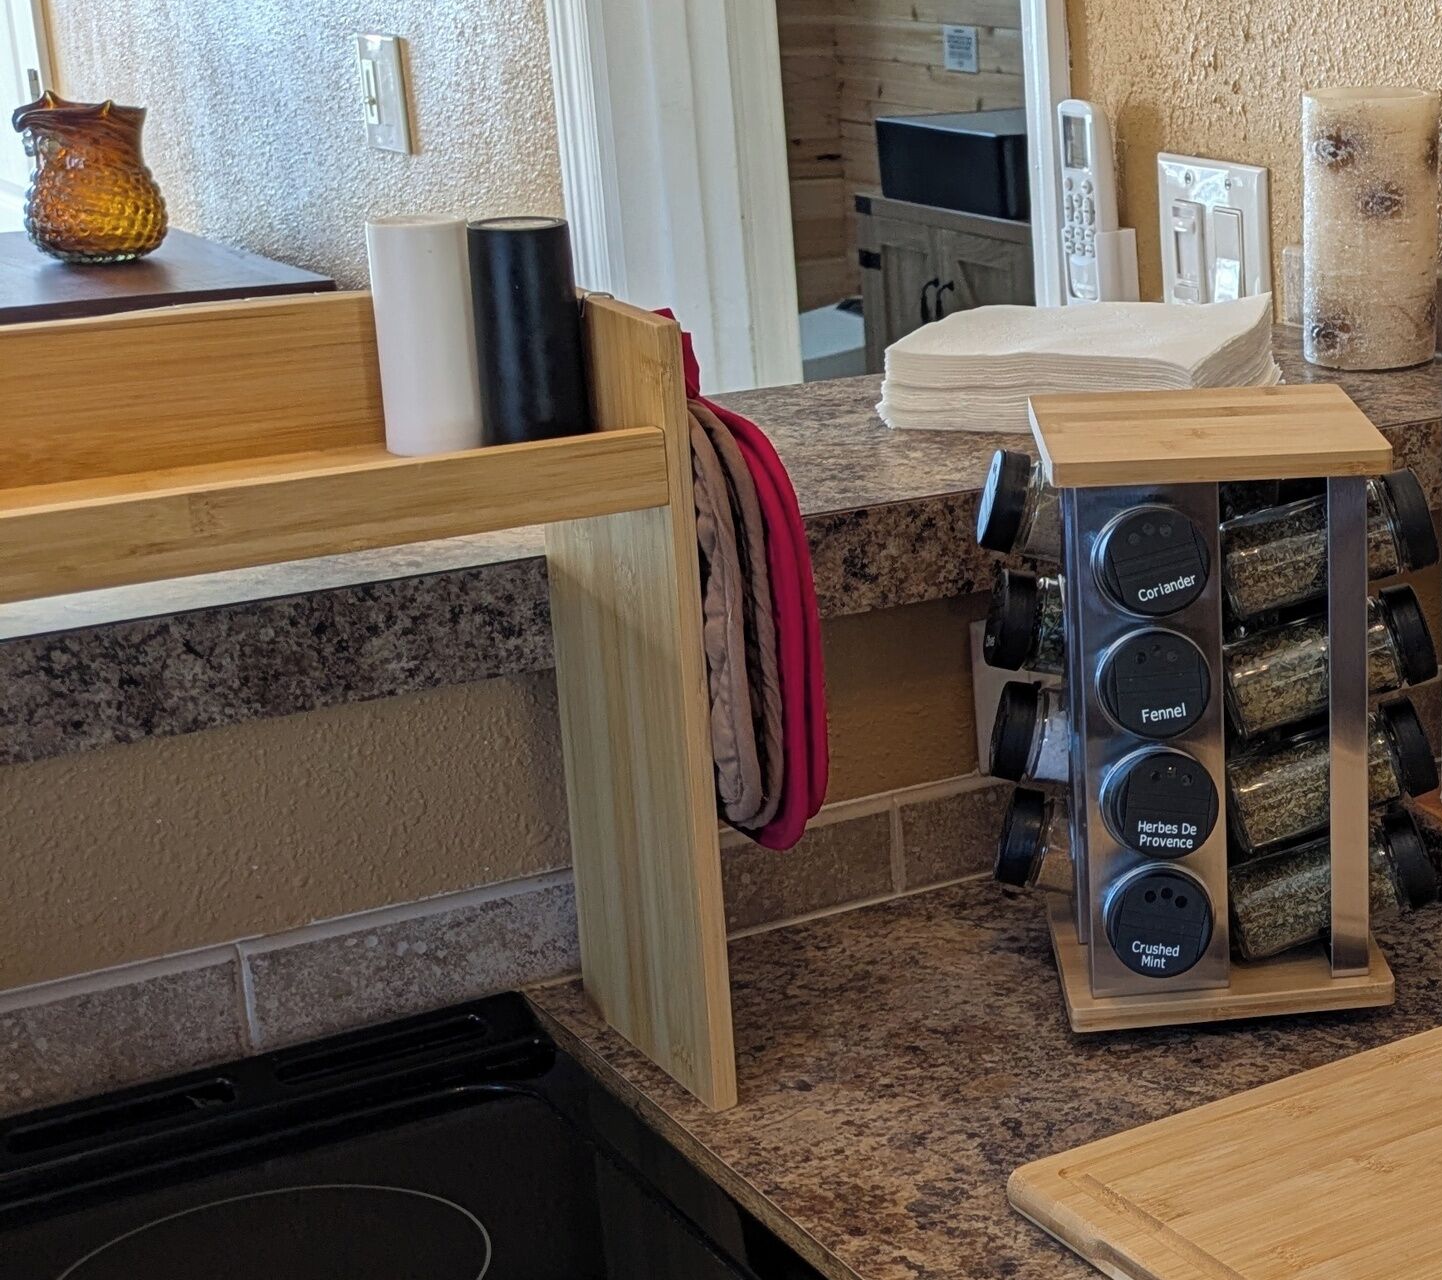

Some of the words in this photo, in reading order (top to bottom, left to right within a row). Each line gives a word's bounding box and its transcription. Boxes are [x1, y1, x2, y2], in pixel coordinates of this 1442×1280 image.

[1138, 574, 1196, 602] Coriander
[1141, 702, 1187, 724] Fennel
[1137, 820, 1178, 834] Herbes
[1181, 823, 1198, 836] De
[1139, 834, 1194, 849] Provence
[1131, 940, 1180, 957] Crushed
[1141, 955, 1167, 969] Mint
